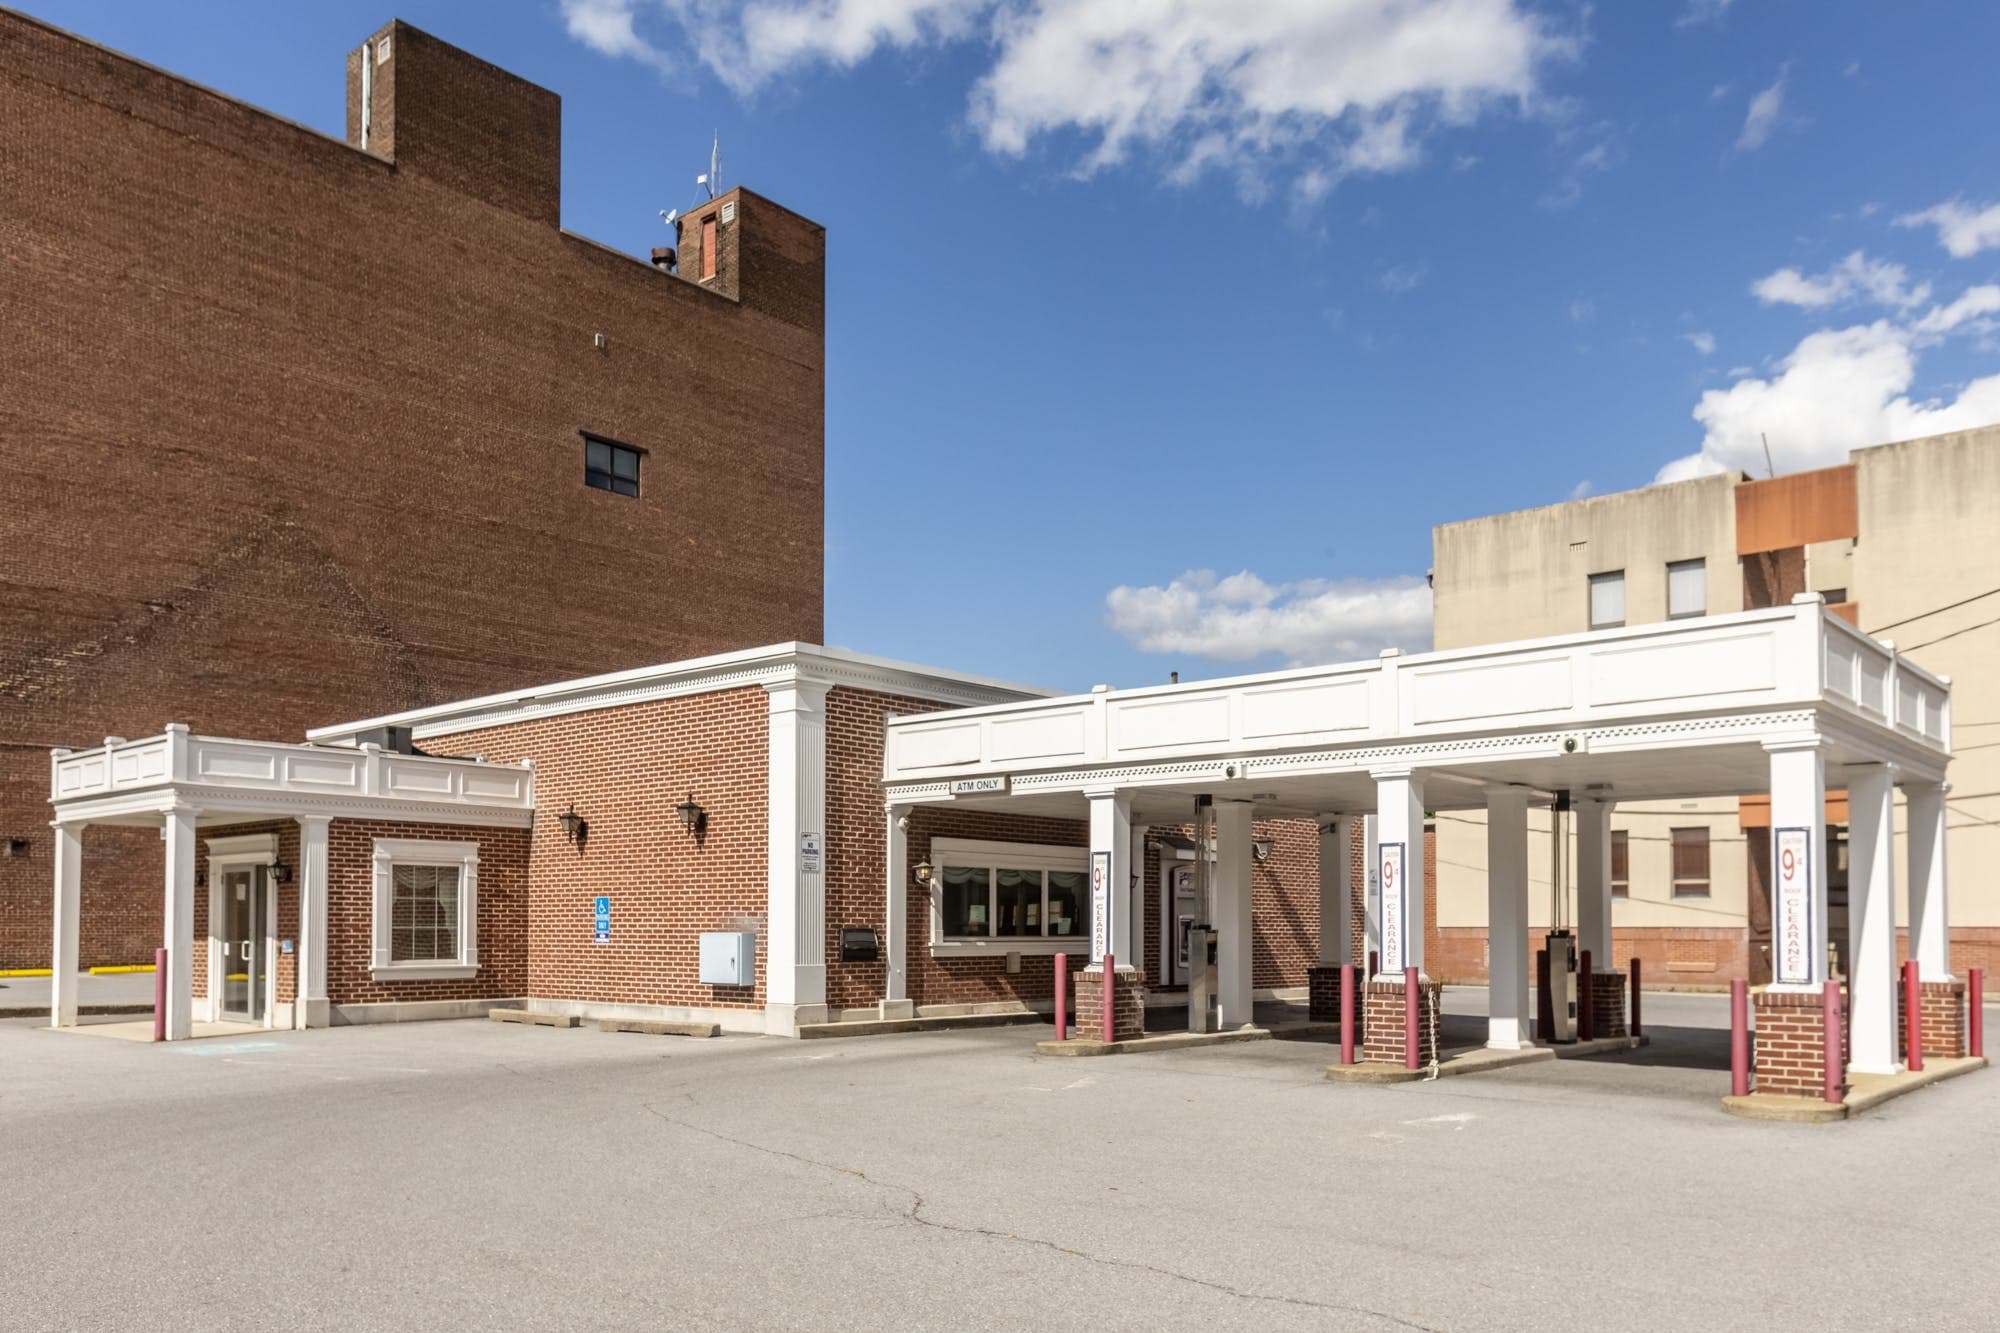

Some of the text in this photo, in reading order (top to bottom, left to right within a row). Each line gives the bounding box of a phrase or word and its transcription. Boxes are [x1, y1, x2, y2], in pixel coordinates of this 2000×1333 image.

[957, 779, 998, 791] ATM ONLY
[1095, 867, 1101, 891] 9
[1384, 861, 1393, 888] 9
[1783, 848, 1795, 881] 9
[1096, 903, 1104, 957] CLEARANCE
[1387, 903, 1396, 965] CLEARANCE
[1787, 899, 1800, 972] CLEARANCE
